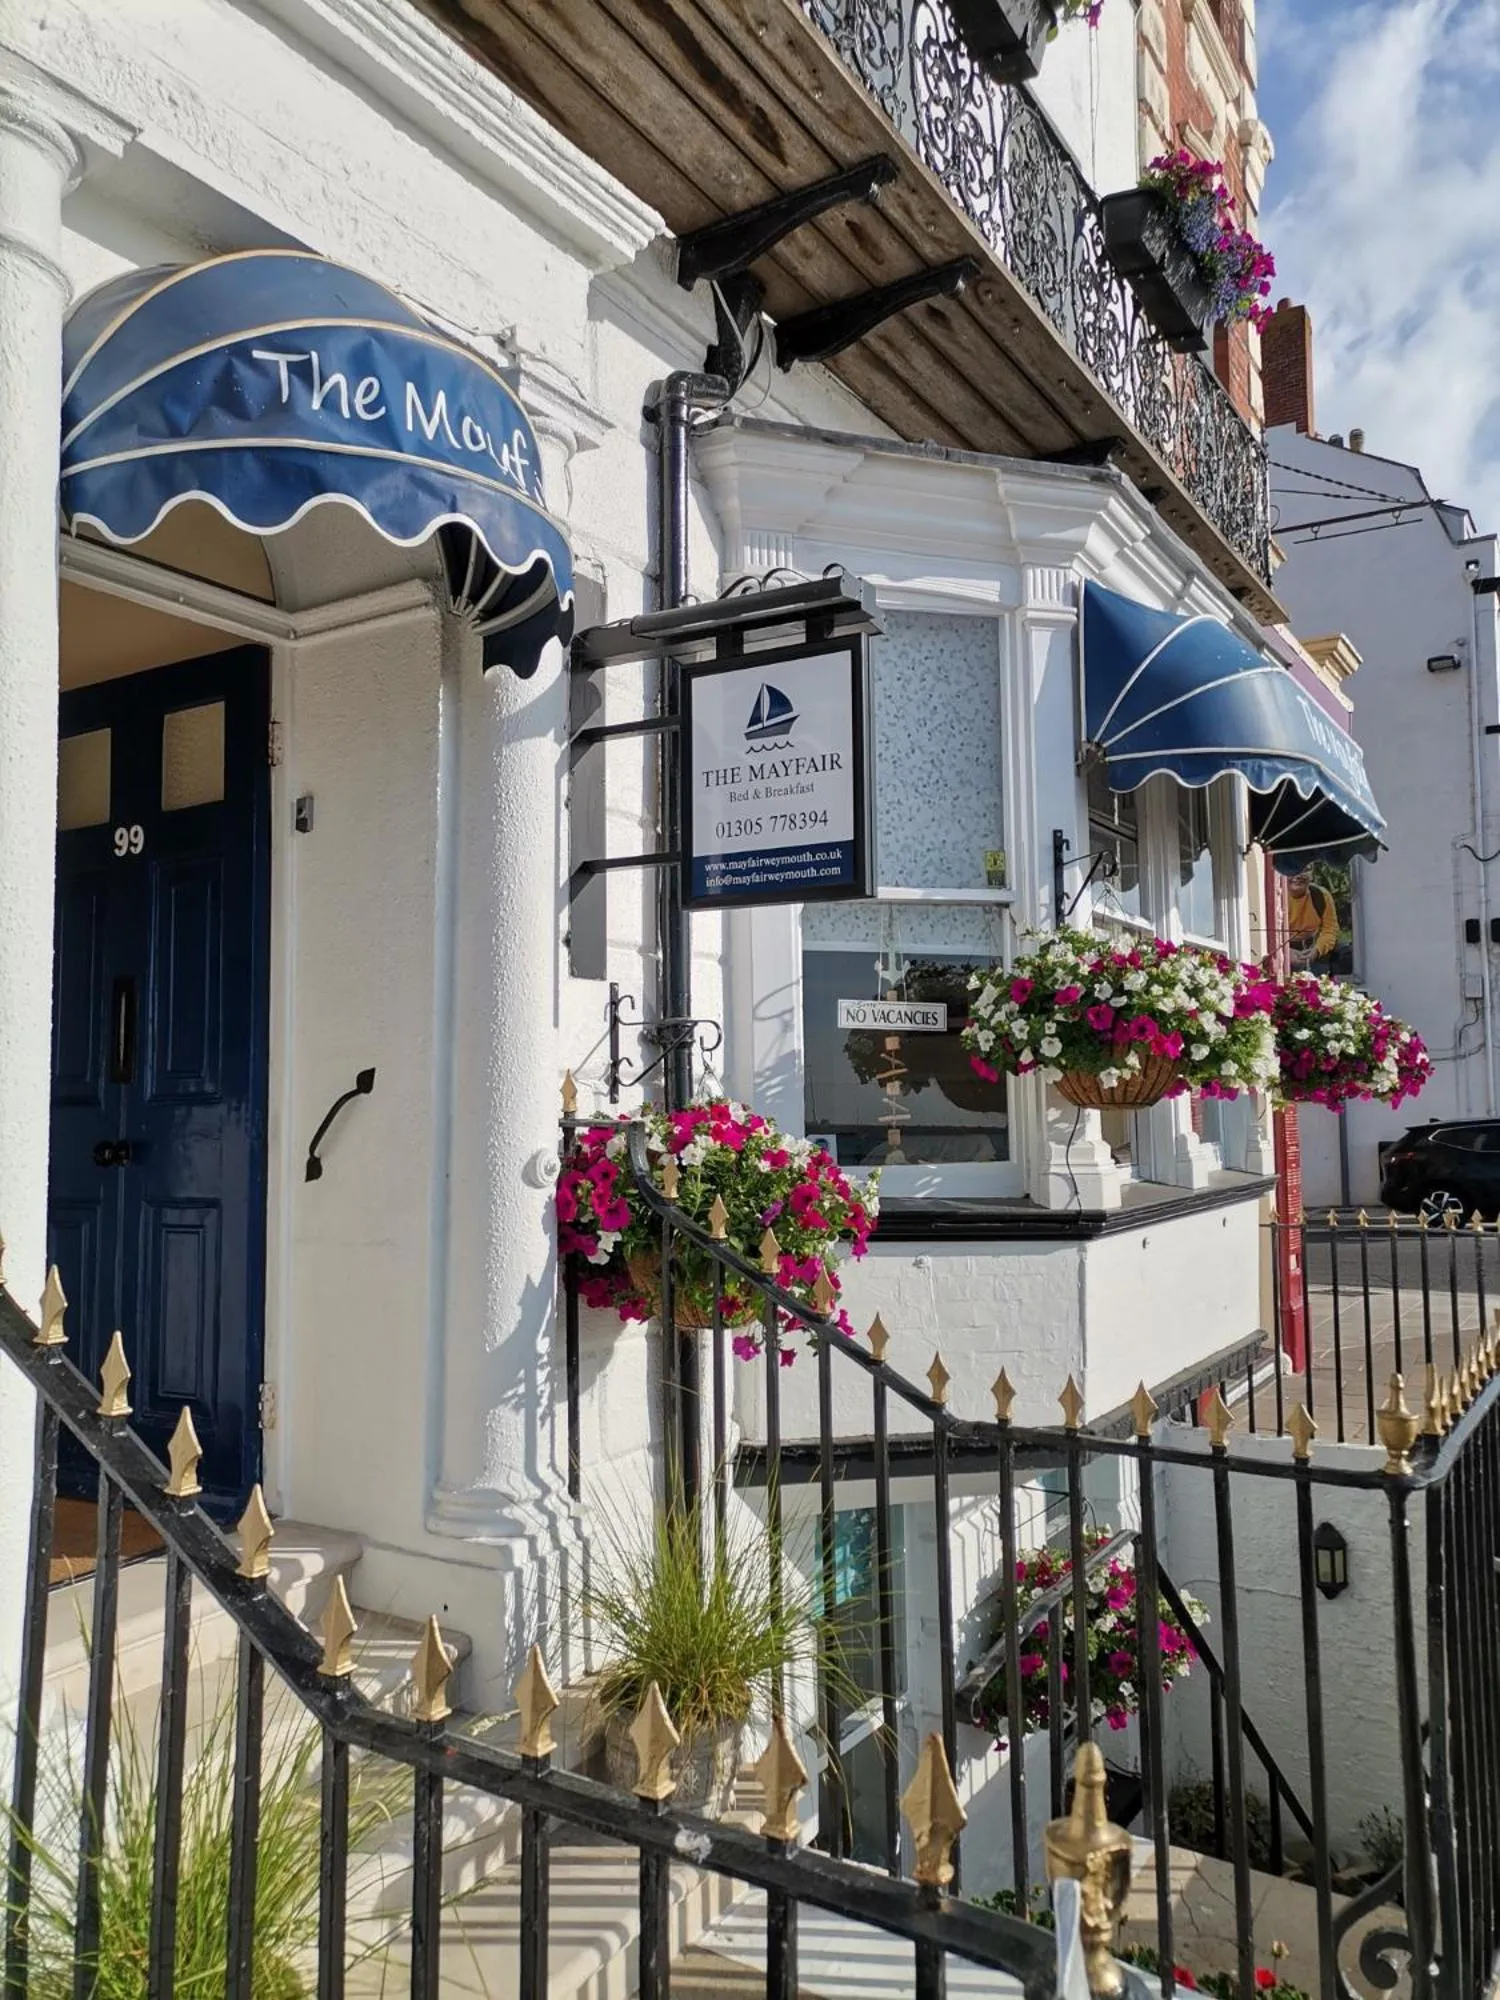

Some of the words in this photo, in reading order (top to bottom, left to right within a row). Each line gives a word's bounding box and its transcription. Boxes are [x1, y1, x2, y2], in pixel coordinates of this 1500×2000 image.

[252, 350, 386, 421] The
[702, 766, 742, 788] THE
[748, 752, 843, 782] MAYFAIR
[729, 789, 749, 803] Bed
[752, 789, 762, 801] &
[765, 782, 815, 799] Breakfast
[715, 817, 763, 839] 01305
[770, 809, 829, 833] 778394
[114, 825, 144, 856] 99
[704, 848, 842, 872] www.mayfairweymouth.co.uk
[705, 866, 841, 888] info@mayfairweymouth.com
[846, 1009, 866, 1024] NO
[872, 1009, 938, 1026] VACANCIES
